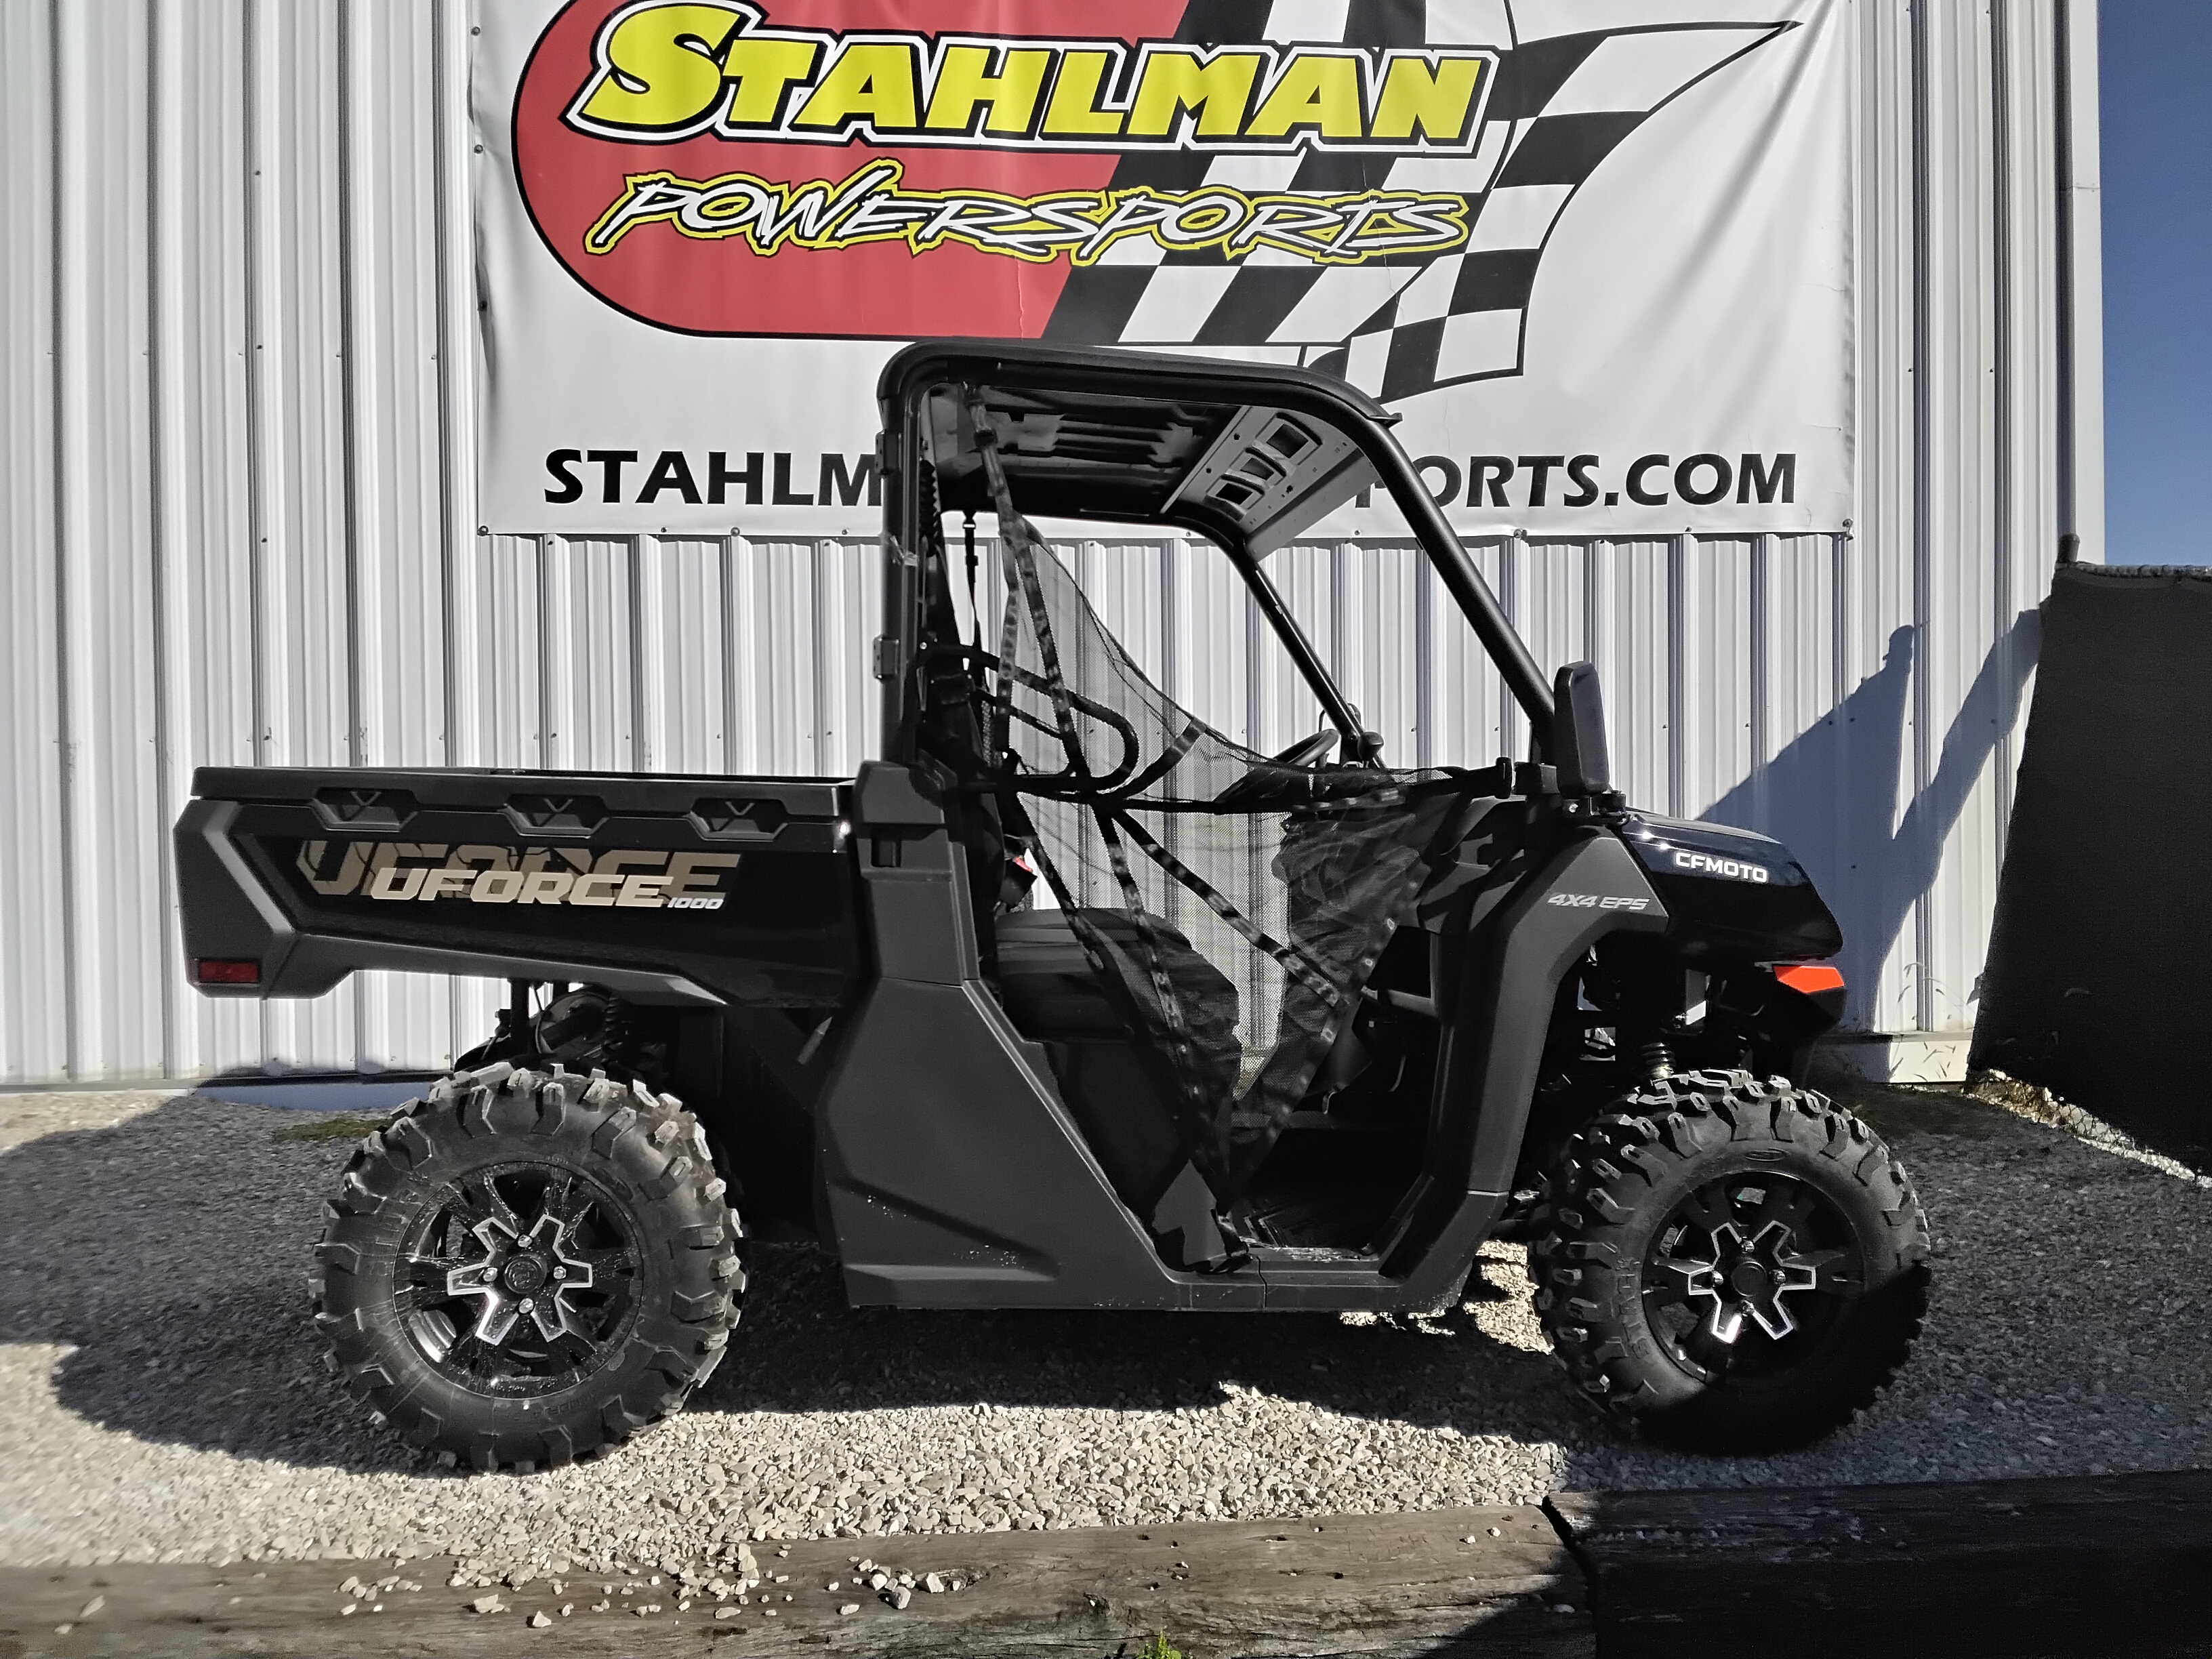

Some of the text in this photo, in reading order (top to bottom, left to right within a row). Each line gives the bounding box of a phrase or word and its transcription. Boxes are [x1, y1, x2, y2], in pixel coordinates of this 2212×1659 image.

[569, 1, 1490, 144] STAHLMAN
[591, 166, 1462, 259] POWERSPORTS
[370, 867, 724, 910] UFORCE 1000
[1675, 852, 1769, 883] CFMOTO
[1547, 893, 1650, 911] 4X4 EPS
